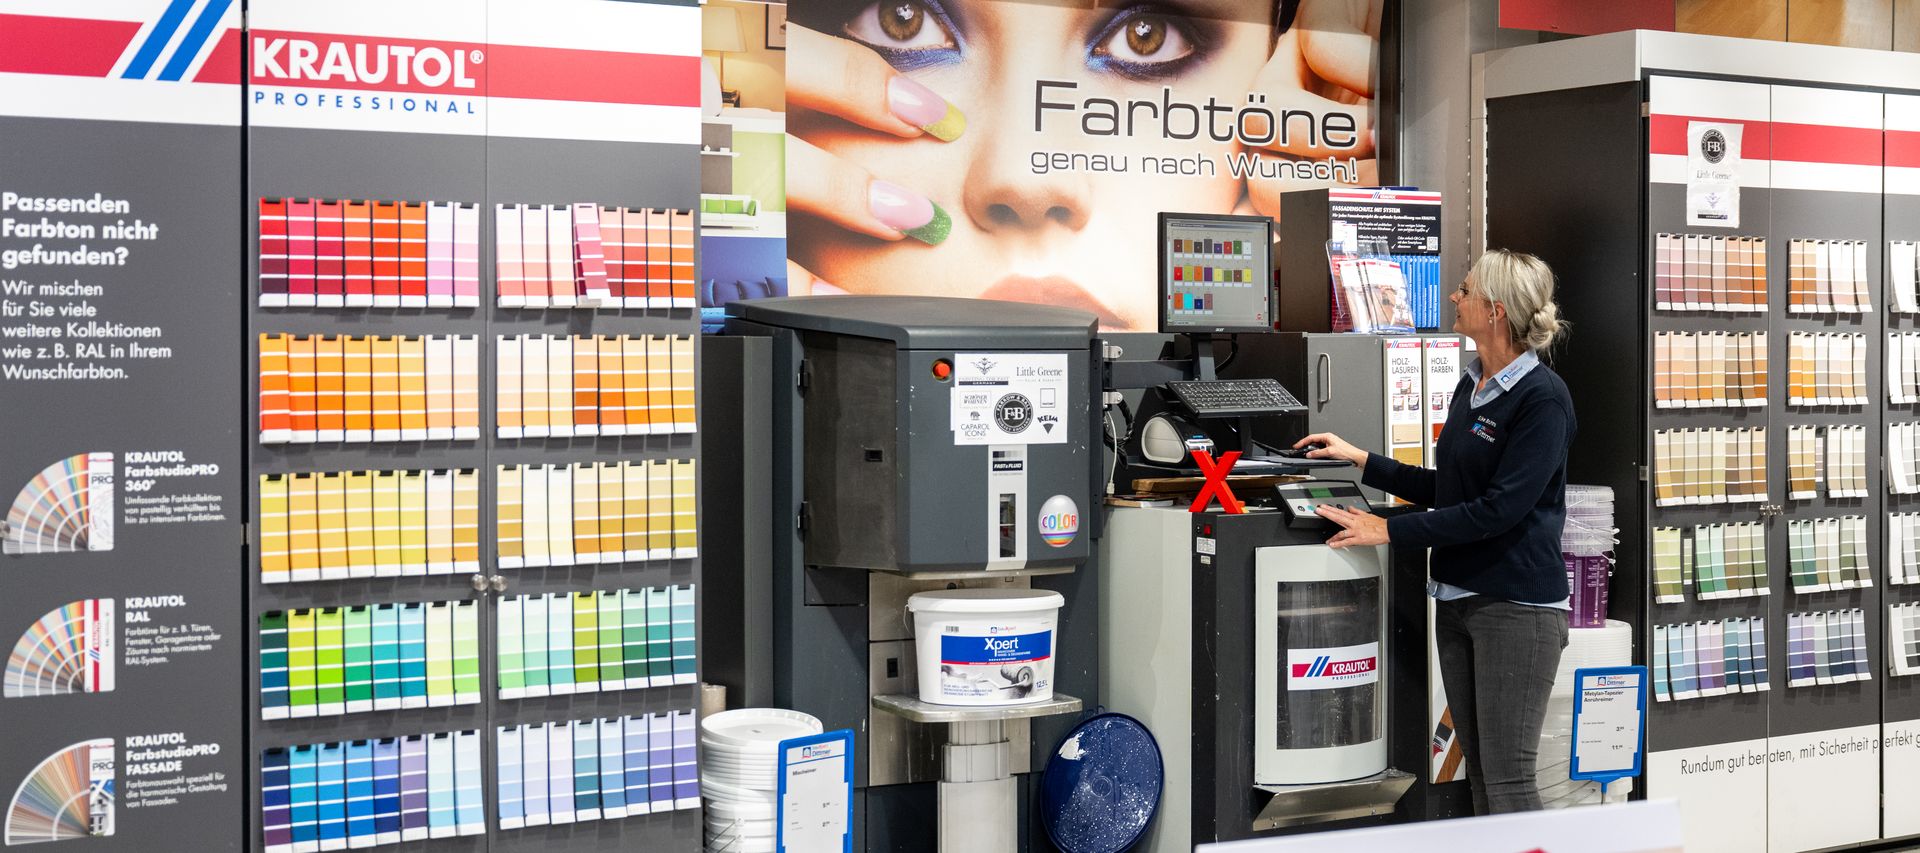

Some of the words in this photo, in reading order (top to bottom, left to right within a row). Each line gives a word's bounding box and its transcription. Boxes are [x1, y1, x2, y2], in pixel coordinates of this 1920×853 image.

[255, 91, 475, 115] PROFESSIONAL
[1034, 79, 1358, 148] Farbtöne
[1030, 151, 1128, 175] genau
[1142, 153, 1215, 176] nach
[1225, 153, 1358, 182] Wunsch!
[2, 192, 130, 214] Passenden
[2, 217, 96, 239] Farbton
[103, 219, 159, 240] nicht
[2, 243, 129, 269] gefunden?
[2, 279, 34, 296] Wir
[40, 279, 103, 296] mischen
[2, 300, 24, 316] für
[29, 301, 55, 316] Sie
[59, 300, 97, 316] viele
[2, 323, 62, 337] weitere
[67, 321, 161, 338] Kollektionen
[2, 344, 32, 359] wie
[76, 343, 105, 359] RAL
[111, 344, 124, 358] in
[129, 342, 172, 359] Ihrem
[1392, 357, 1411, 366] HOLZ-
[1431, 357, 1449, 365] HOLZ-
[2, 362, 129, 380] Wunschfarbton.
[1016, 366, 1035, 377] Little
[1037, 366, 1063, 377] Greene
[1392, 366, 1419, 374] LASUREN
[1431, 366, 1454, 374] FARBEN
[125, 451, 186, 464] KRAUTOL
[125, 463, 219, 478] FarbstudioPRO
[125, 479, 156, 492] 360°
[125, 496, 170, 505] Umfassende
[171, 494, 222, 503] Farbkollektion
[209, 503, 221, 511] bis
[125, 515, 137, 524] hin
[150, 515, 186, 523] intensiven
[1042, 513, 1077, 531] COLOR
[125, 595, 186, 609] KRAUTOL
[125, 611, 151, 623] RAL
[125, 627, 158, 636] Farbtöne
[160, 625, 170, 635] für
[125, 636, 153, 646] Fenster,
[155, 634, 203, 645] Garagentore
[204, 633, 221, 641] oder
[984, 637, 1019, 657] Xpert
[125, 646, 149, 656] Zäune
[151, 645, 169, 654] nach
[171, 643, 212, 653] normiertem
[126, 732, 186, 748] KRAUTOL
[126, 743, 220, 762] FarbstudioPRO
[1681, 755, 1725, 775] Rundum
[1727, 756, 1745, 774] gut
[1800, 745, 1816, 759] mit
[1819, 736, 1869, 756] Sicherheit
[126, 760, 183, 776] FASSADE
[126, 776, 184, 789] Farbtonauswahl
[215, 772, 225, 781] für
[126, 790, 139, 799] die
[140, 787, 187, 798] harmonische
[188, 783, 227, 794] Gestaltung
